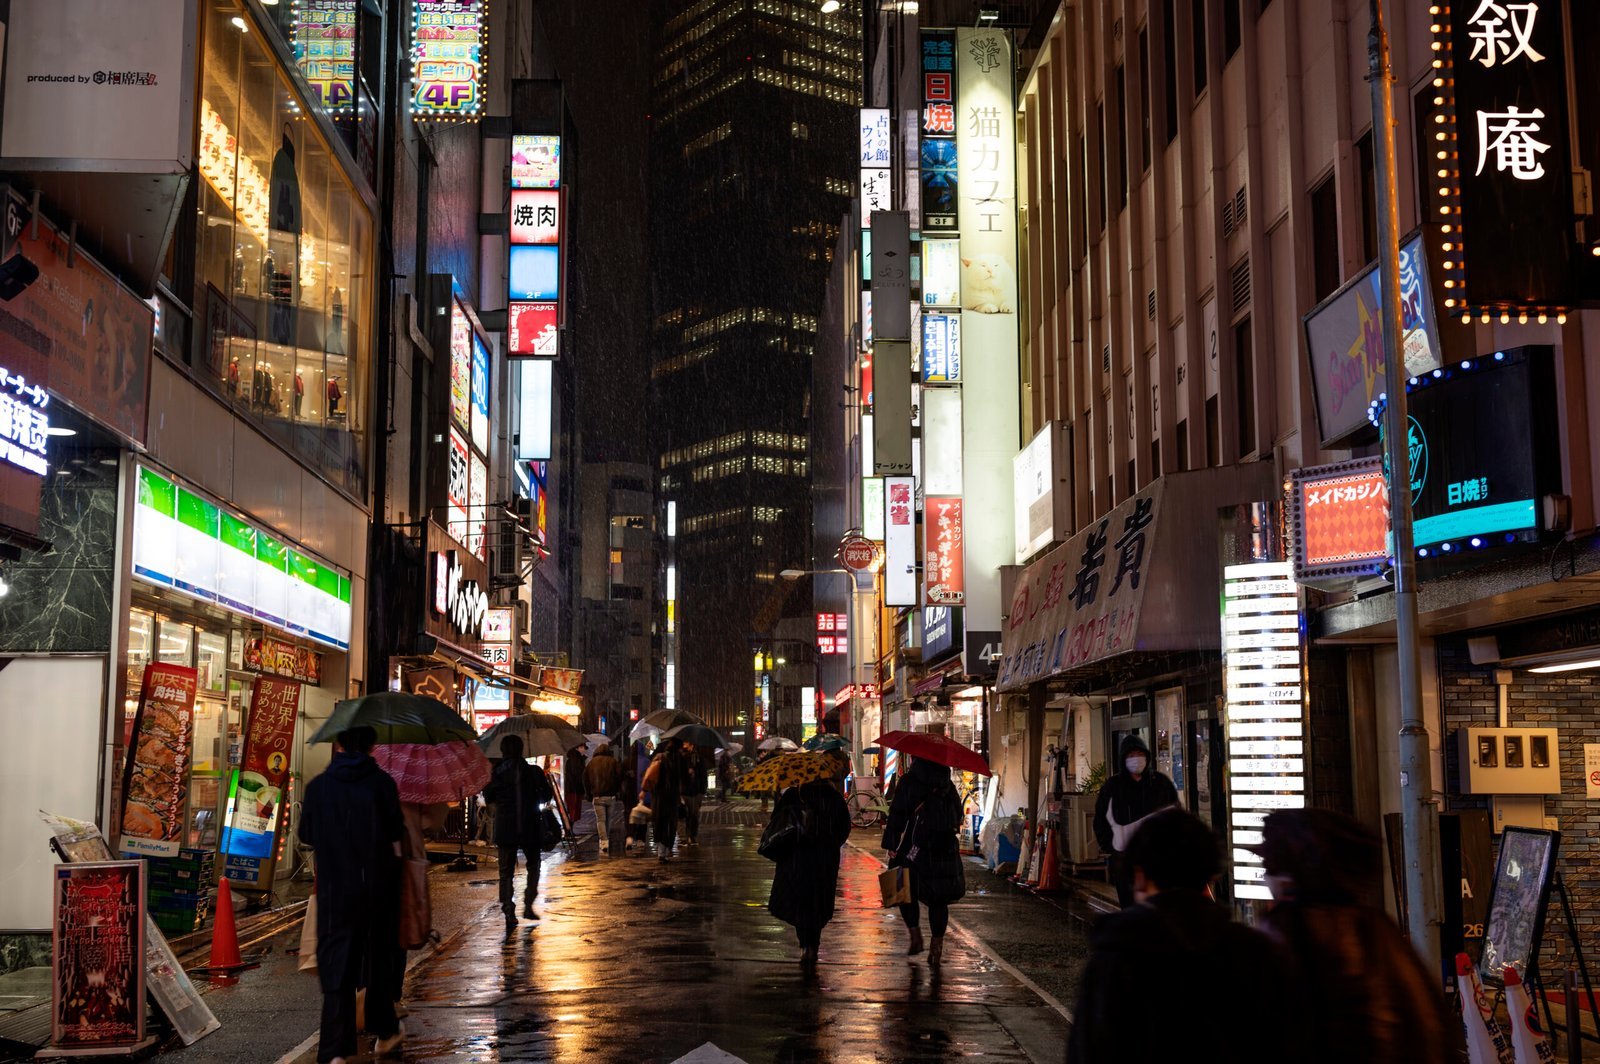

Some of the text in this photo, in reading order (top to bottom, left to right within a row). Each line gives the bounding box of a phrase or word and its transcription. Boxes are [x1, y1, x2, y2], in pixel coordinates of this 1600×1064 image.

[924, 40, 952, 54] 完全
[27, 74, 75, 83] produced
[78, 74, 90, 84] by
[1466, 0, 1551, 180] 叙庵
[423, 85, 470, 106] 4F
[925, 73, 955, 132] 日焼
[862, 125, 875, 161] ウィル
[876, 115, 888, 161] 占いの館
[969, 107, 1005, 233] 猫カフェ
[514, 204, 556, 228] 焼肉
[935, 217, 947, 225] 3F
[526, 291, 542, 299] 2F
[925, 292, 938, 304] 6F
[950, 318, 960, 380] カードゲームショップ
[876, 462, 912, 470] マージャン
[1307, 482, 1382, 507] メイドカジノ
[1447, 478, 1480, 505] 日焼
[1481, 477, 1489, 500] サロン
[890, 483, 911, 526] 麻雀
[953, 502, 962, 549] メイドカジノ
[937, 503, 953, 581] アキバギルド
[847, 551, 871, 561] 消火栓
[154, 685, 187, 703] 肉弁当
[271, 683, 296, 751] 世界一の
[136, 841, 170, 854] FamilyMart
[231, 856, 255, 867] たばこ
[230, 869, 256, 882] お酒
[1463, 923, 1484, 939] 26
